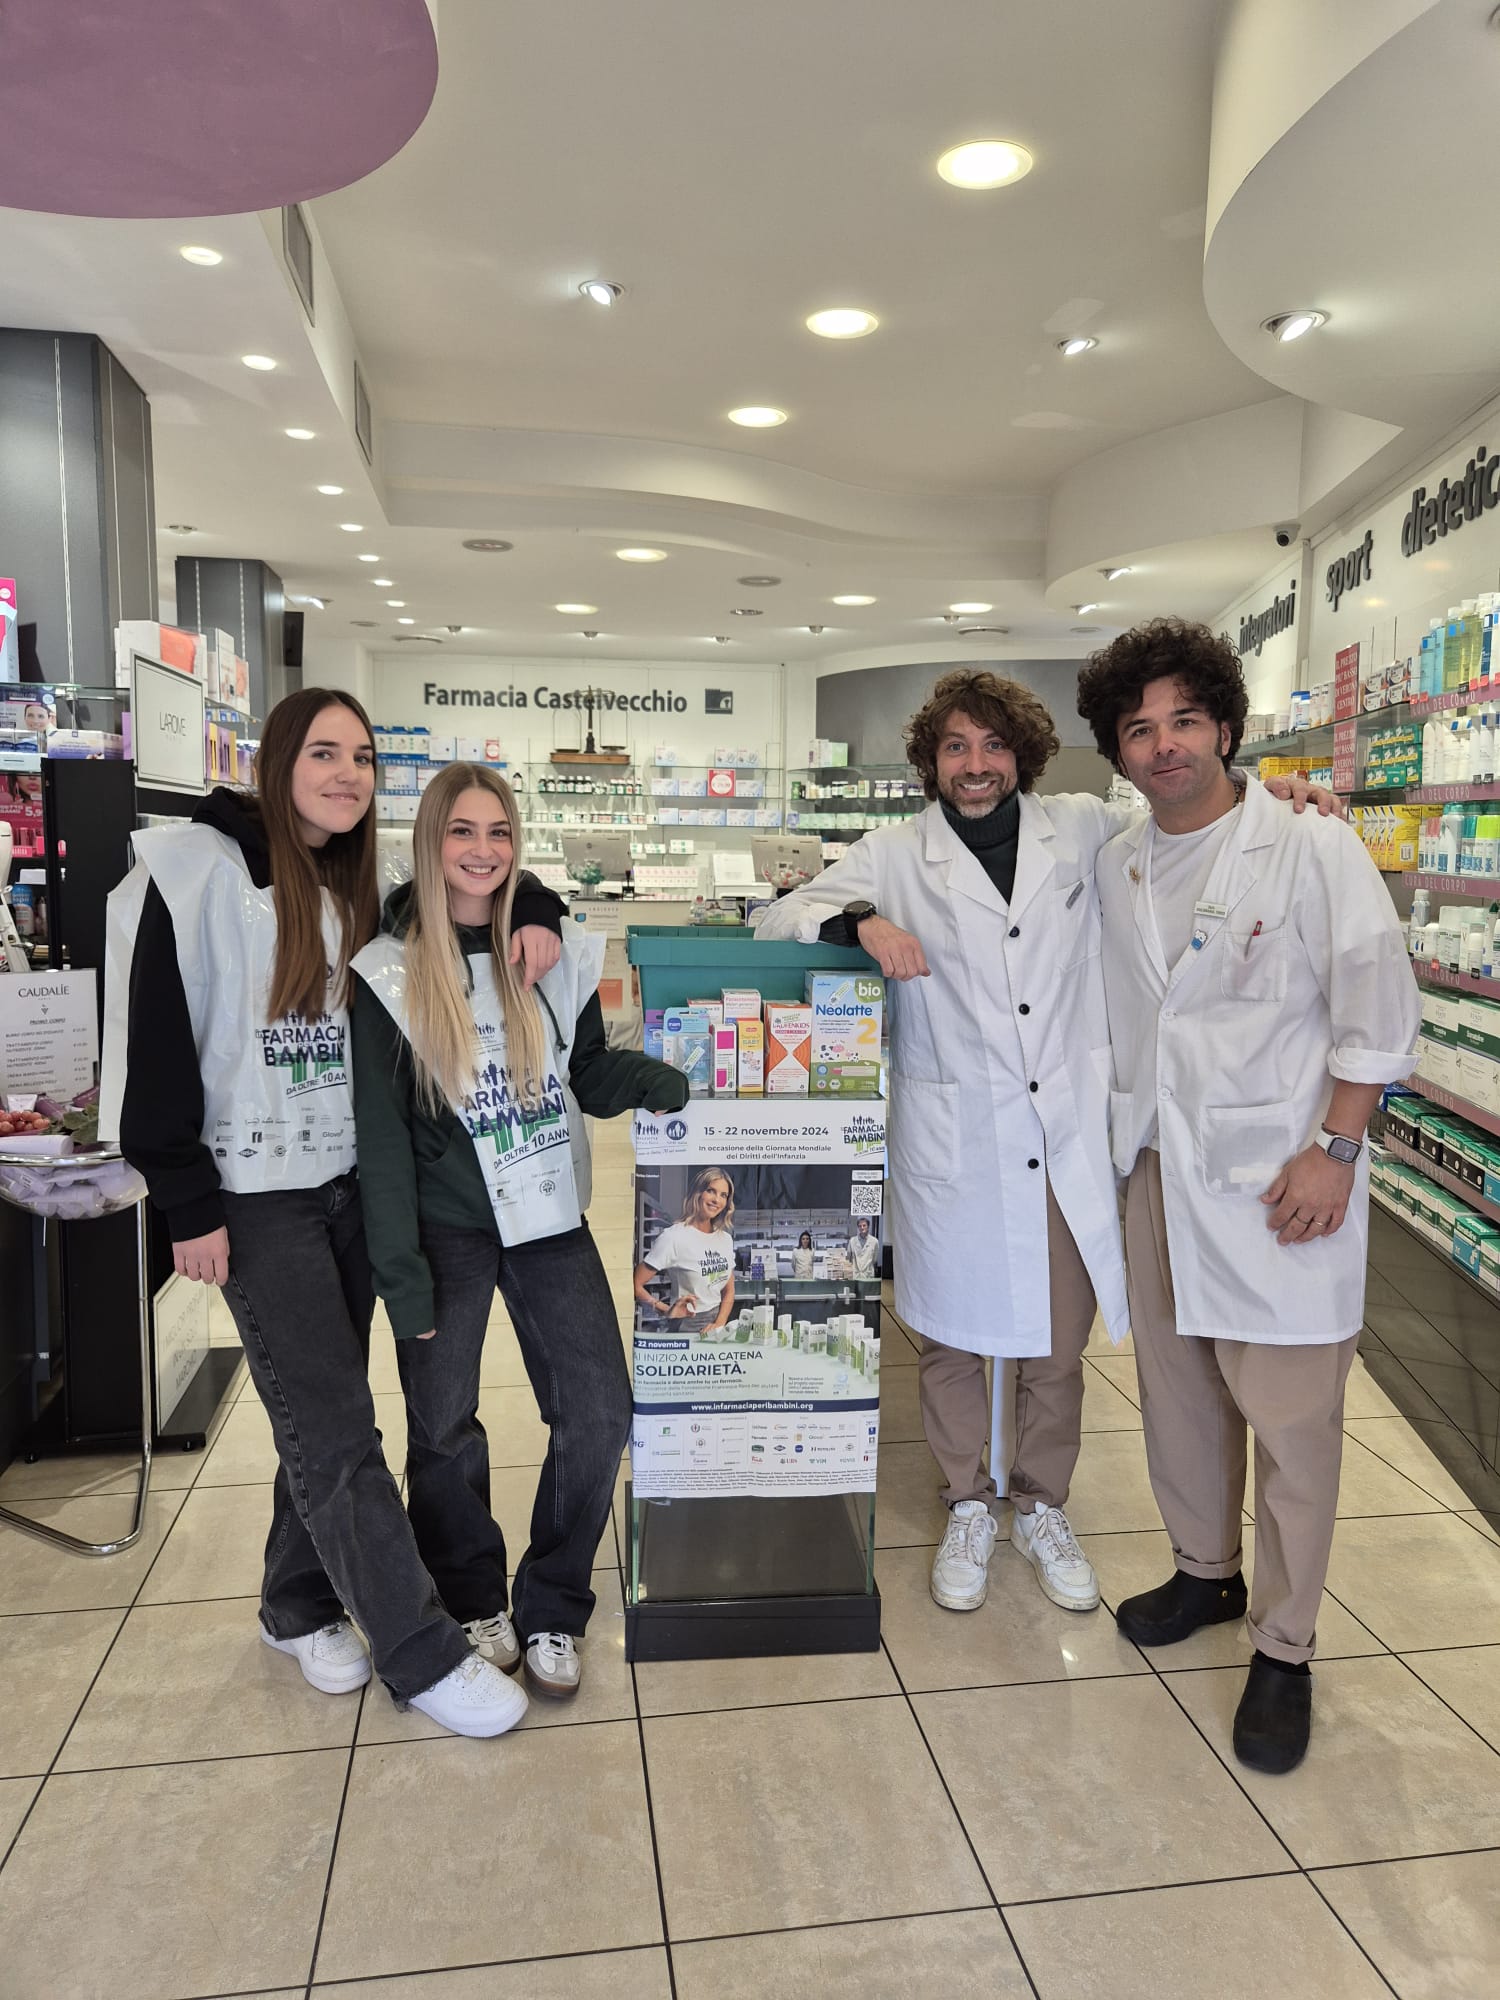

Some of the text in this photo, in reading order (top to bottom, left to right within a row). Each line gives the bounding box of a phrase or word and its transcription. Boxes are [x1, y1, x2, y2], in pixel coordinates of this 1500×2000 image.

[1401, 446, 1500, 557] dietetic
[1326, 529, 1374, 612] sport
[1239, 579, 1296, 656] integratori
[424, 683, 688, 713] Farmacia Castelvecchio
[1433, 697, 1446, 711] DEL
[1429, 788, 1441, 801] DEL
[1446, 785, 1470, 800] CORPO
[1425, 876, 1438, 889] DEL
[1441, 878, 1466, 893] CORPO
[858, 982, 881, 997] bio
[816, 1004, 873, 1016] Neolatte
[857, 1018, 878, 1044] 2
[322, 1072, 333, 1084] 10
[704, 1126, 715, 1136] 15
[725, 1126, 738, 1136] 22
[741, 1126, 799, 1136] novembre
[801, 1126, 829, 1136] 2024
[843, 1124, 885, 1135] FARMACIA
[531, 1133, 545, 1149] 10
[493, 1143, 530, 1170] DA OLTRE
[648, 1340, 687, 1348] novembre
[643, 1353, 678, 1362] INIZIO
[680, 1353, 688, 1362] A
[691, 1352, 716, 1361] UNA
[718, 1350, 763, 1361] CATENA
[636, 1361, 746, 1377] SOLIDARIETÀ.
[691, 1402, 814, 1411] www.infarmaciaperibambini.org
